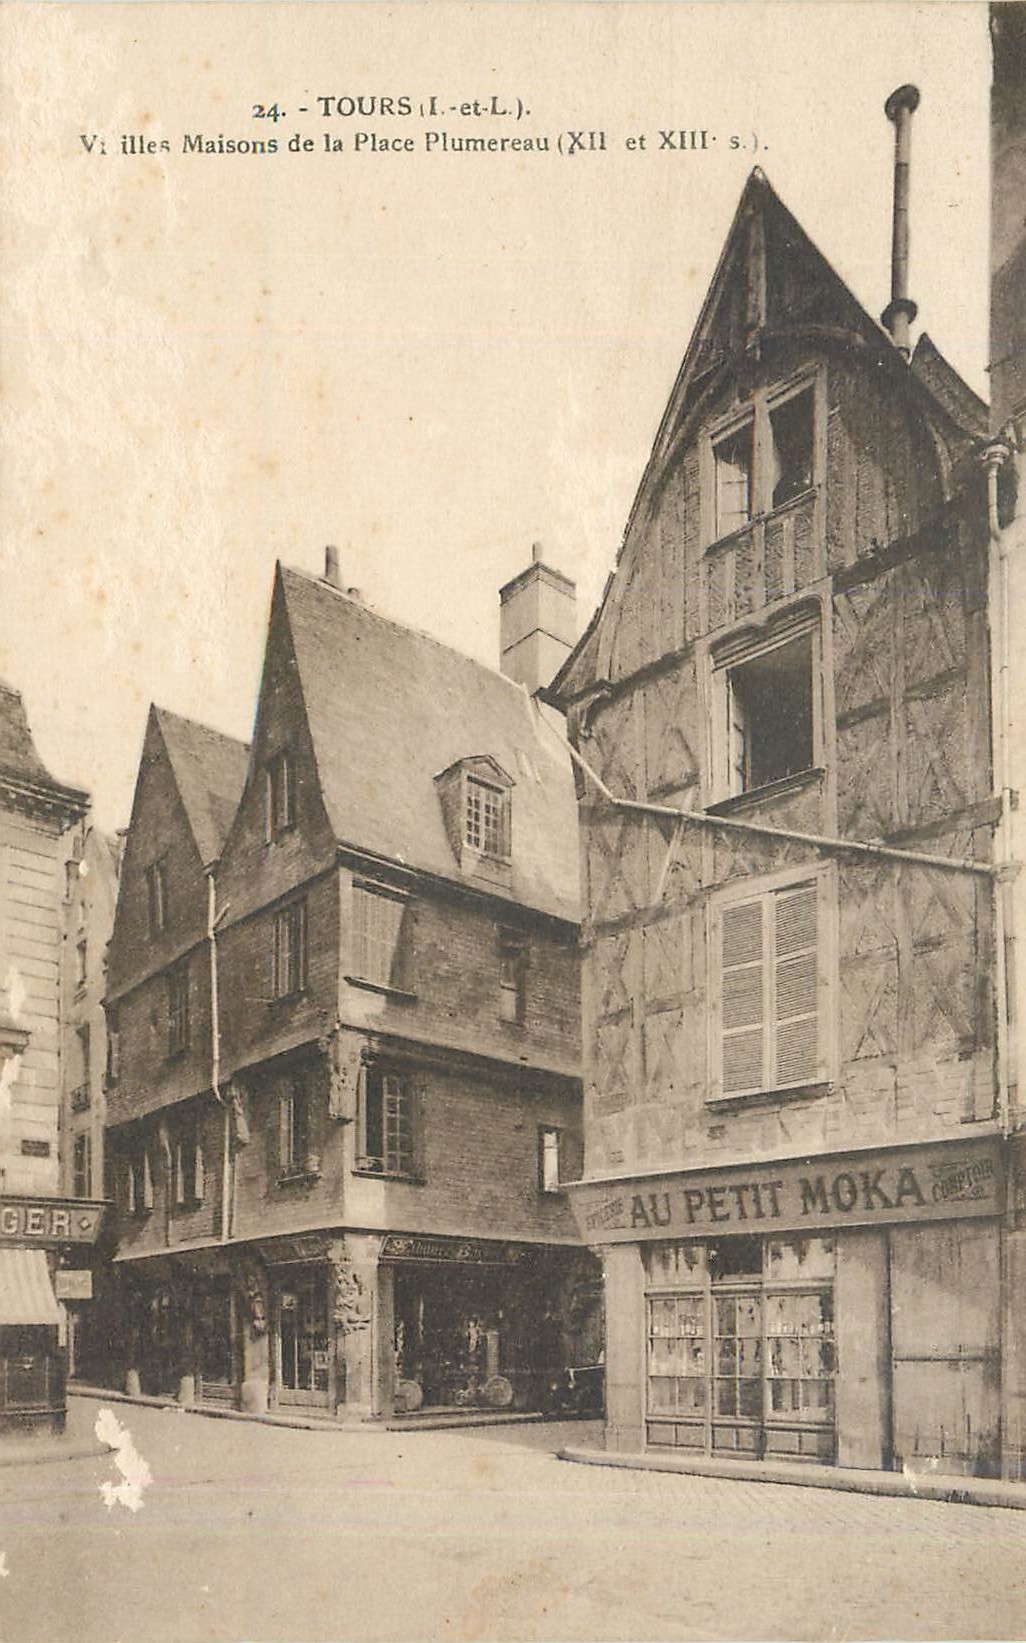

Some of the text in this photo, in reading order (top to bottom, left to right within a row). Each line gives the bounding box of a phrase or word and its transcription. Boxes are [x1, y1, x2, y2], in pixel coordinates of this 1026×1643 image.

[631, 1167, 926, 1229] AU PETIT MOKA
